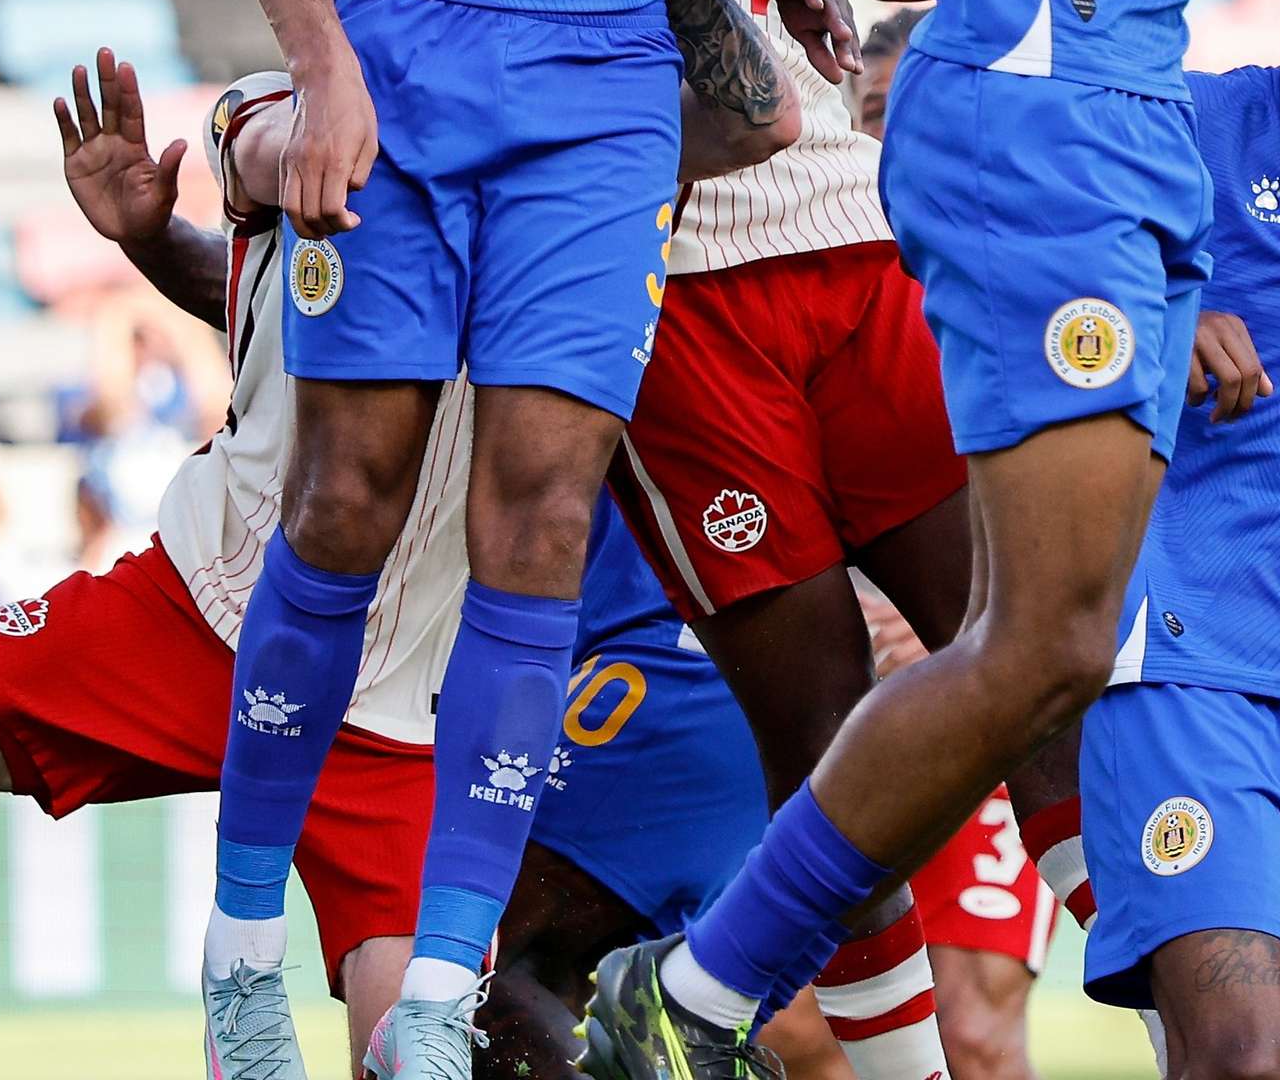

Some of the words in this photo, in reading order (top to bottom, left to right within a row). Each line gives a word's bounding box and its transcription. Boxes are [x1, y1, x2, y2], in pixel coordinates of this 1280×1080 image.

[707, 510, 763, 535] CANADA
[237, 710, 302, 737] KELME
[469, 784, 535, 812] KELME
